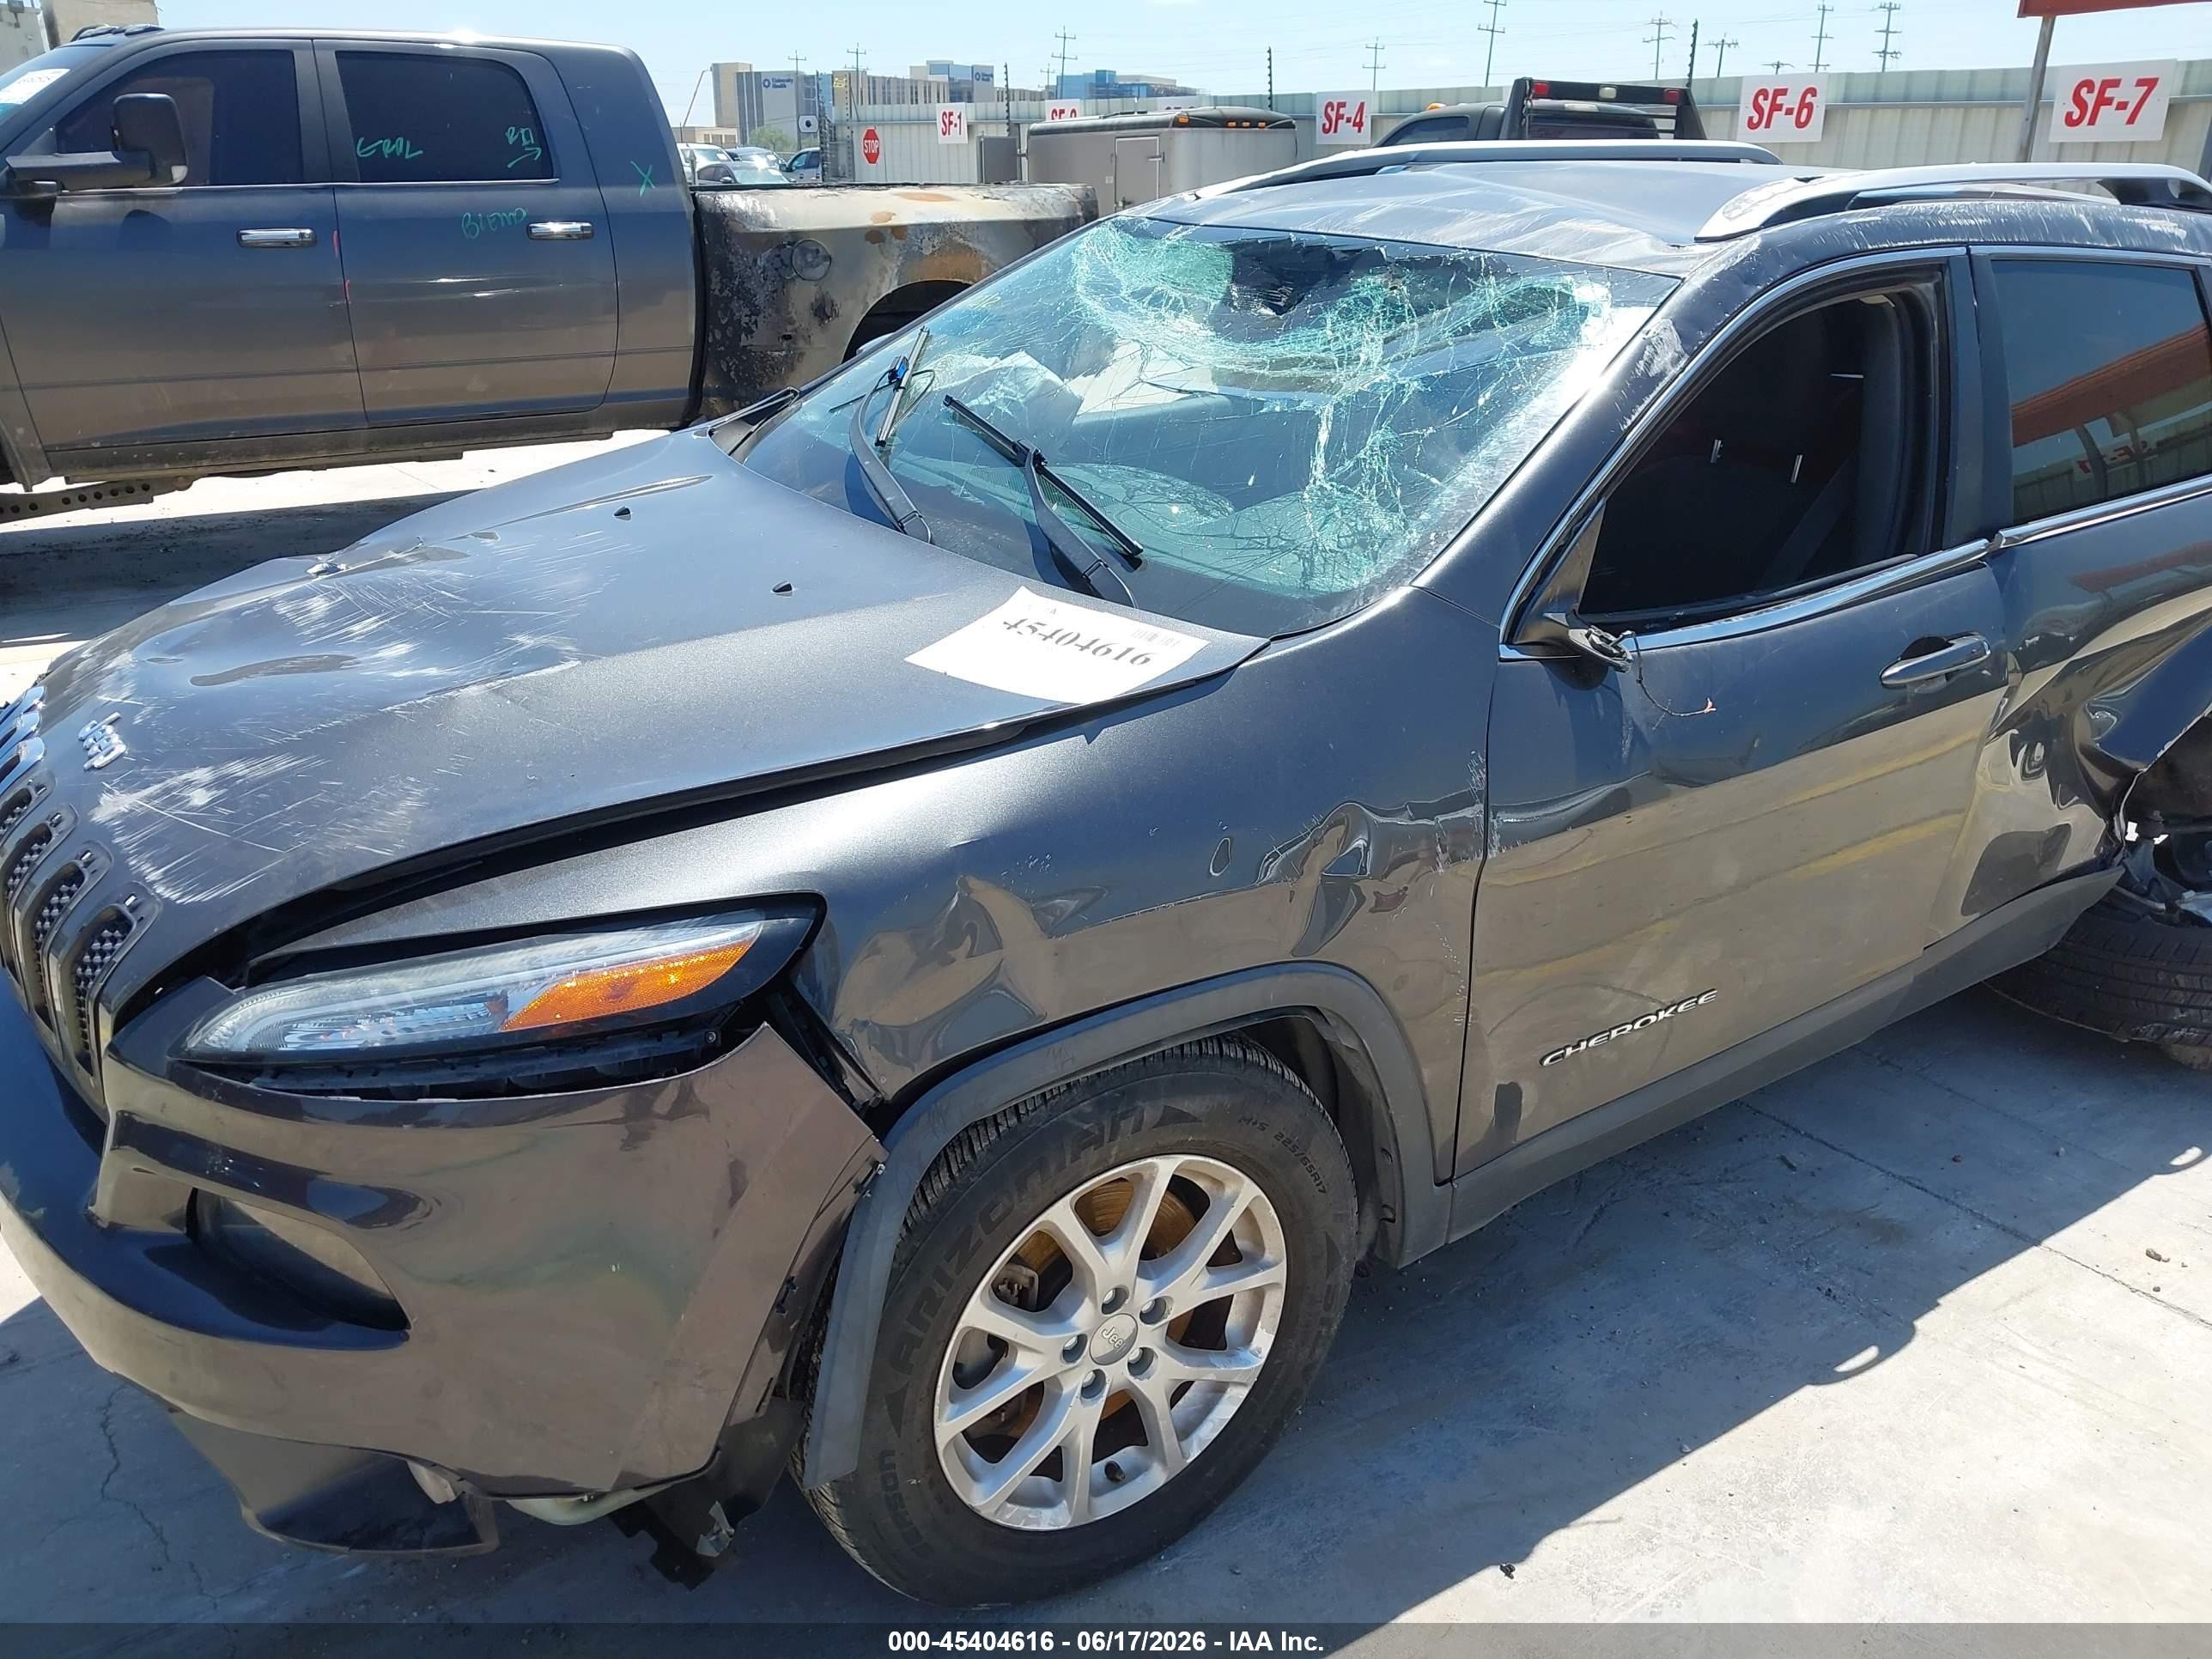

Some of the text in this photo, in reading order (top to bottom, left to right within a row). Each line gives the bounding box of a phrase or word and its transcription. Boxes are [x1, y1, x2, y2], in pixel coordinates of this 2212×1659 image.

[941, 111, 963, 137] SF-1
[1322, 100, 1366, 135] SF-4
[1747, 87, 1818, 131] SF-6
[2064, 77, 2160, 128] SF-7
[864, 139, 879, 154] STOP
[1002, 617, 1158, 666] 45404616
[1539, 988, 1718, 1066] CHEROKEE
[1273, 1130, 1328, 1195] 225/65R17
